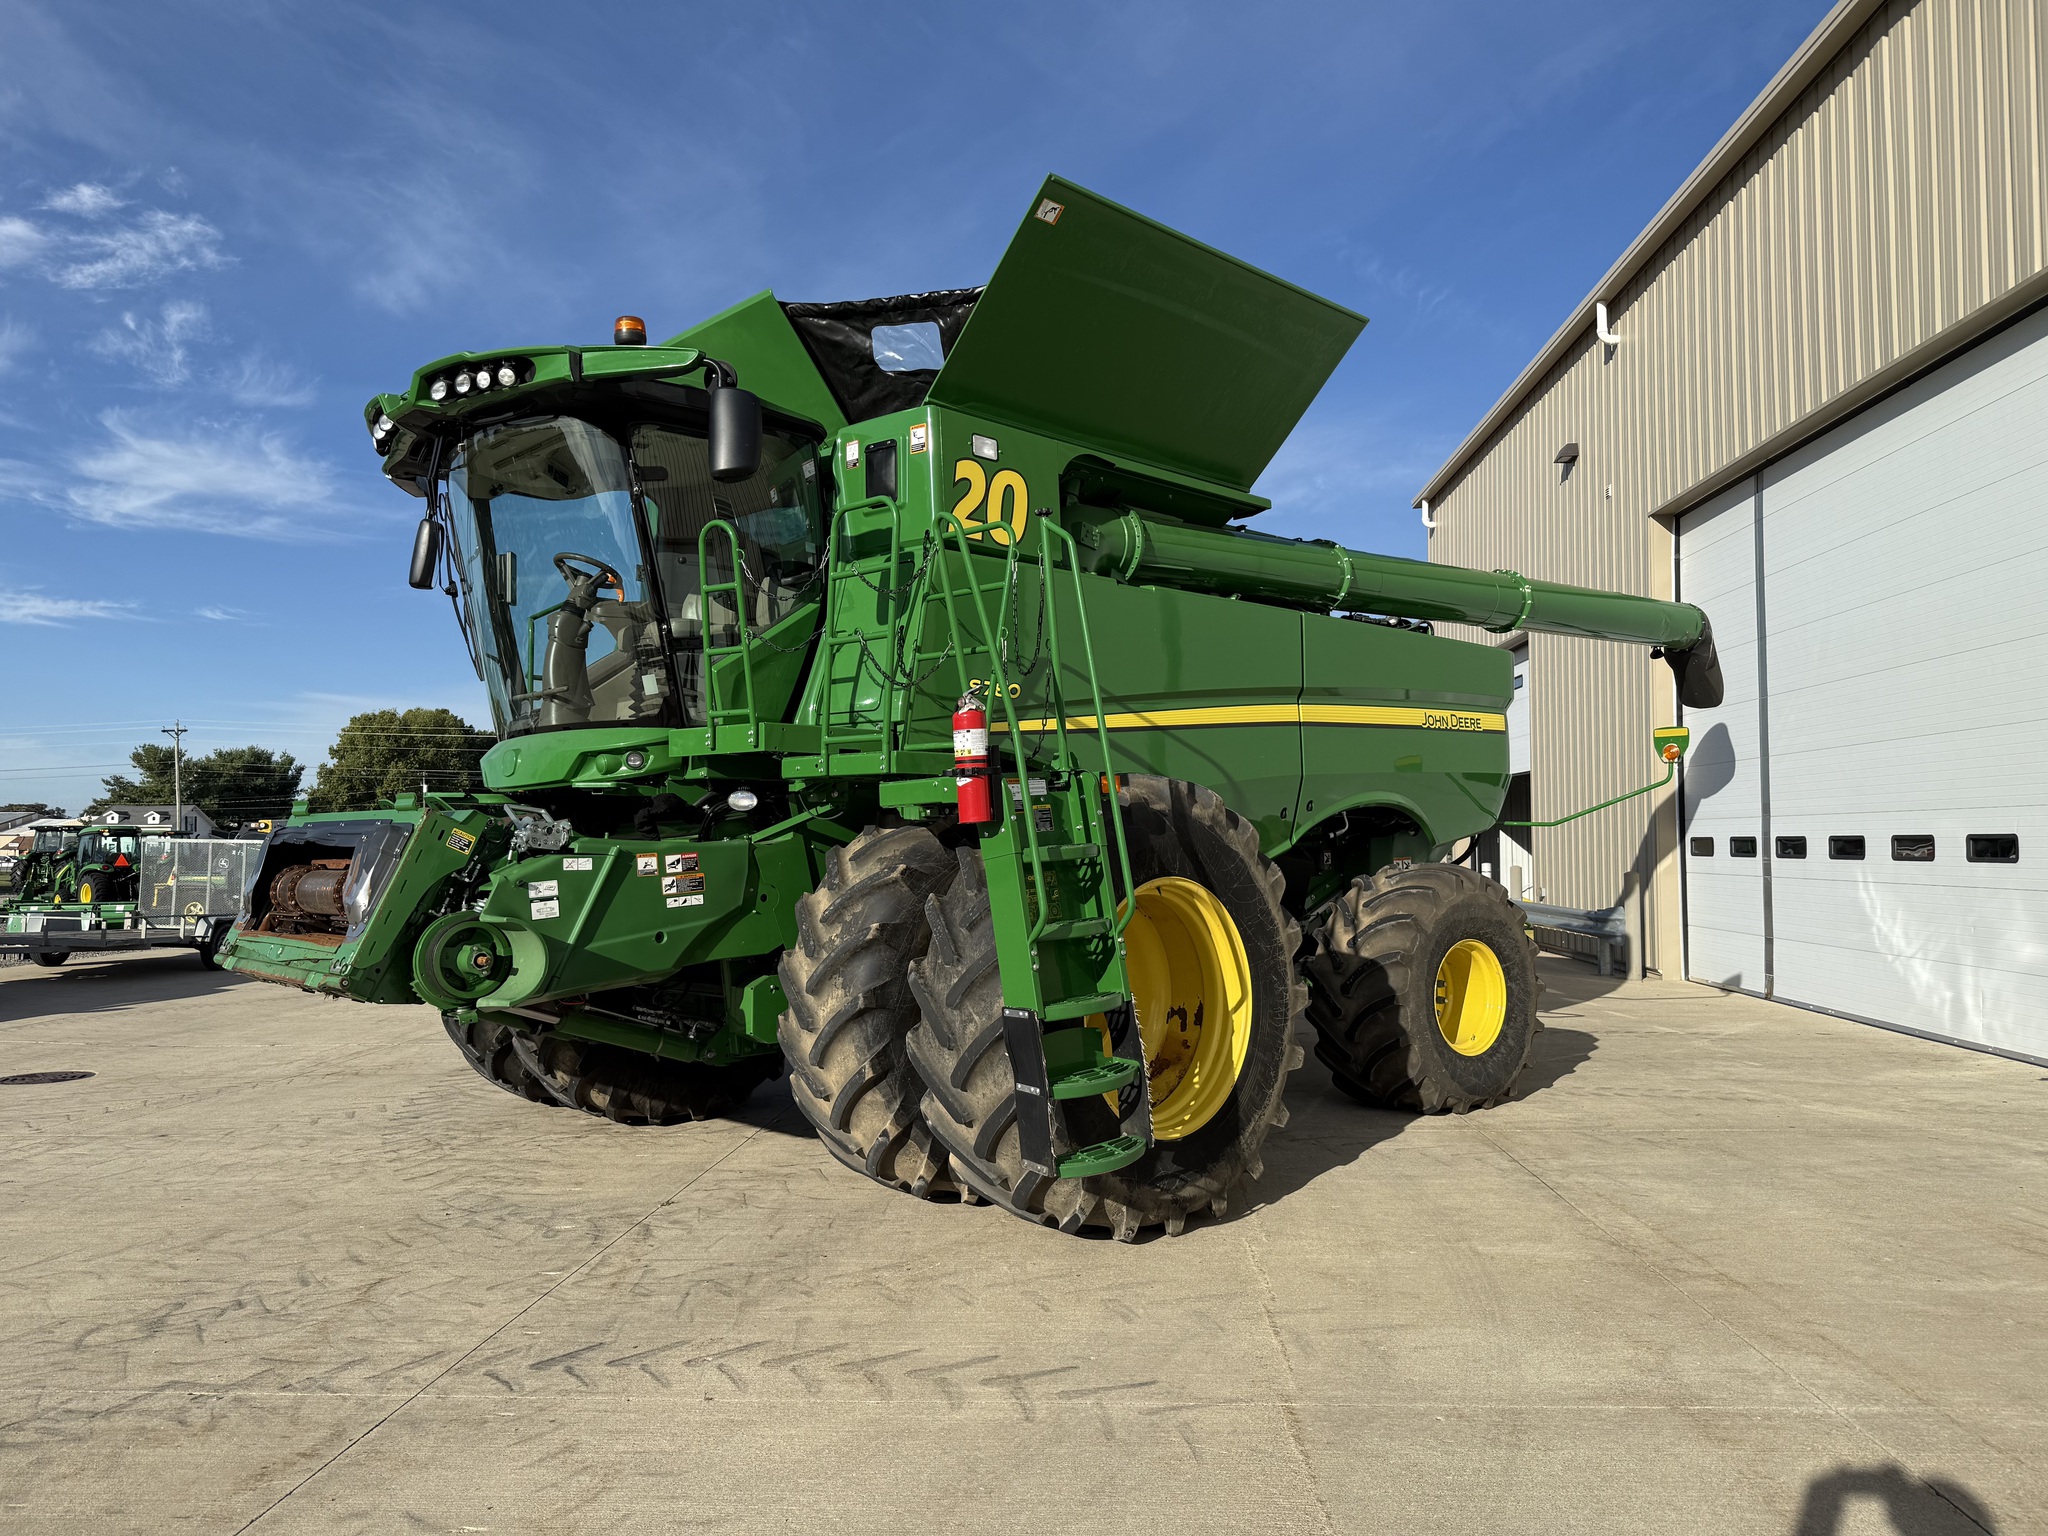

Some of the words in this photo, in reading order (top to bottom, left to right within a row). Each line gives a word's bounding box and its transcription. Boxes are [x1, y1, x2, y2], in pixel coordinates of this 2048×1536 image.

[947, 458, 1029, 547] 20
[1421, 712, 1449, 728] JOHN
[1450, 714, 1483, 730] DEERE
